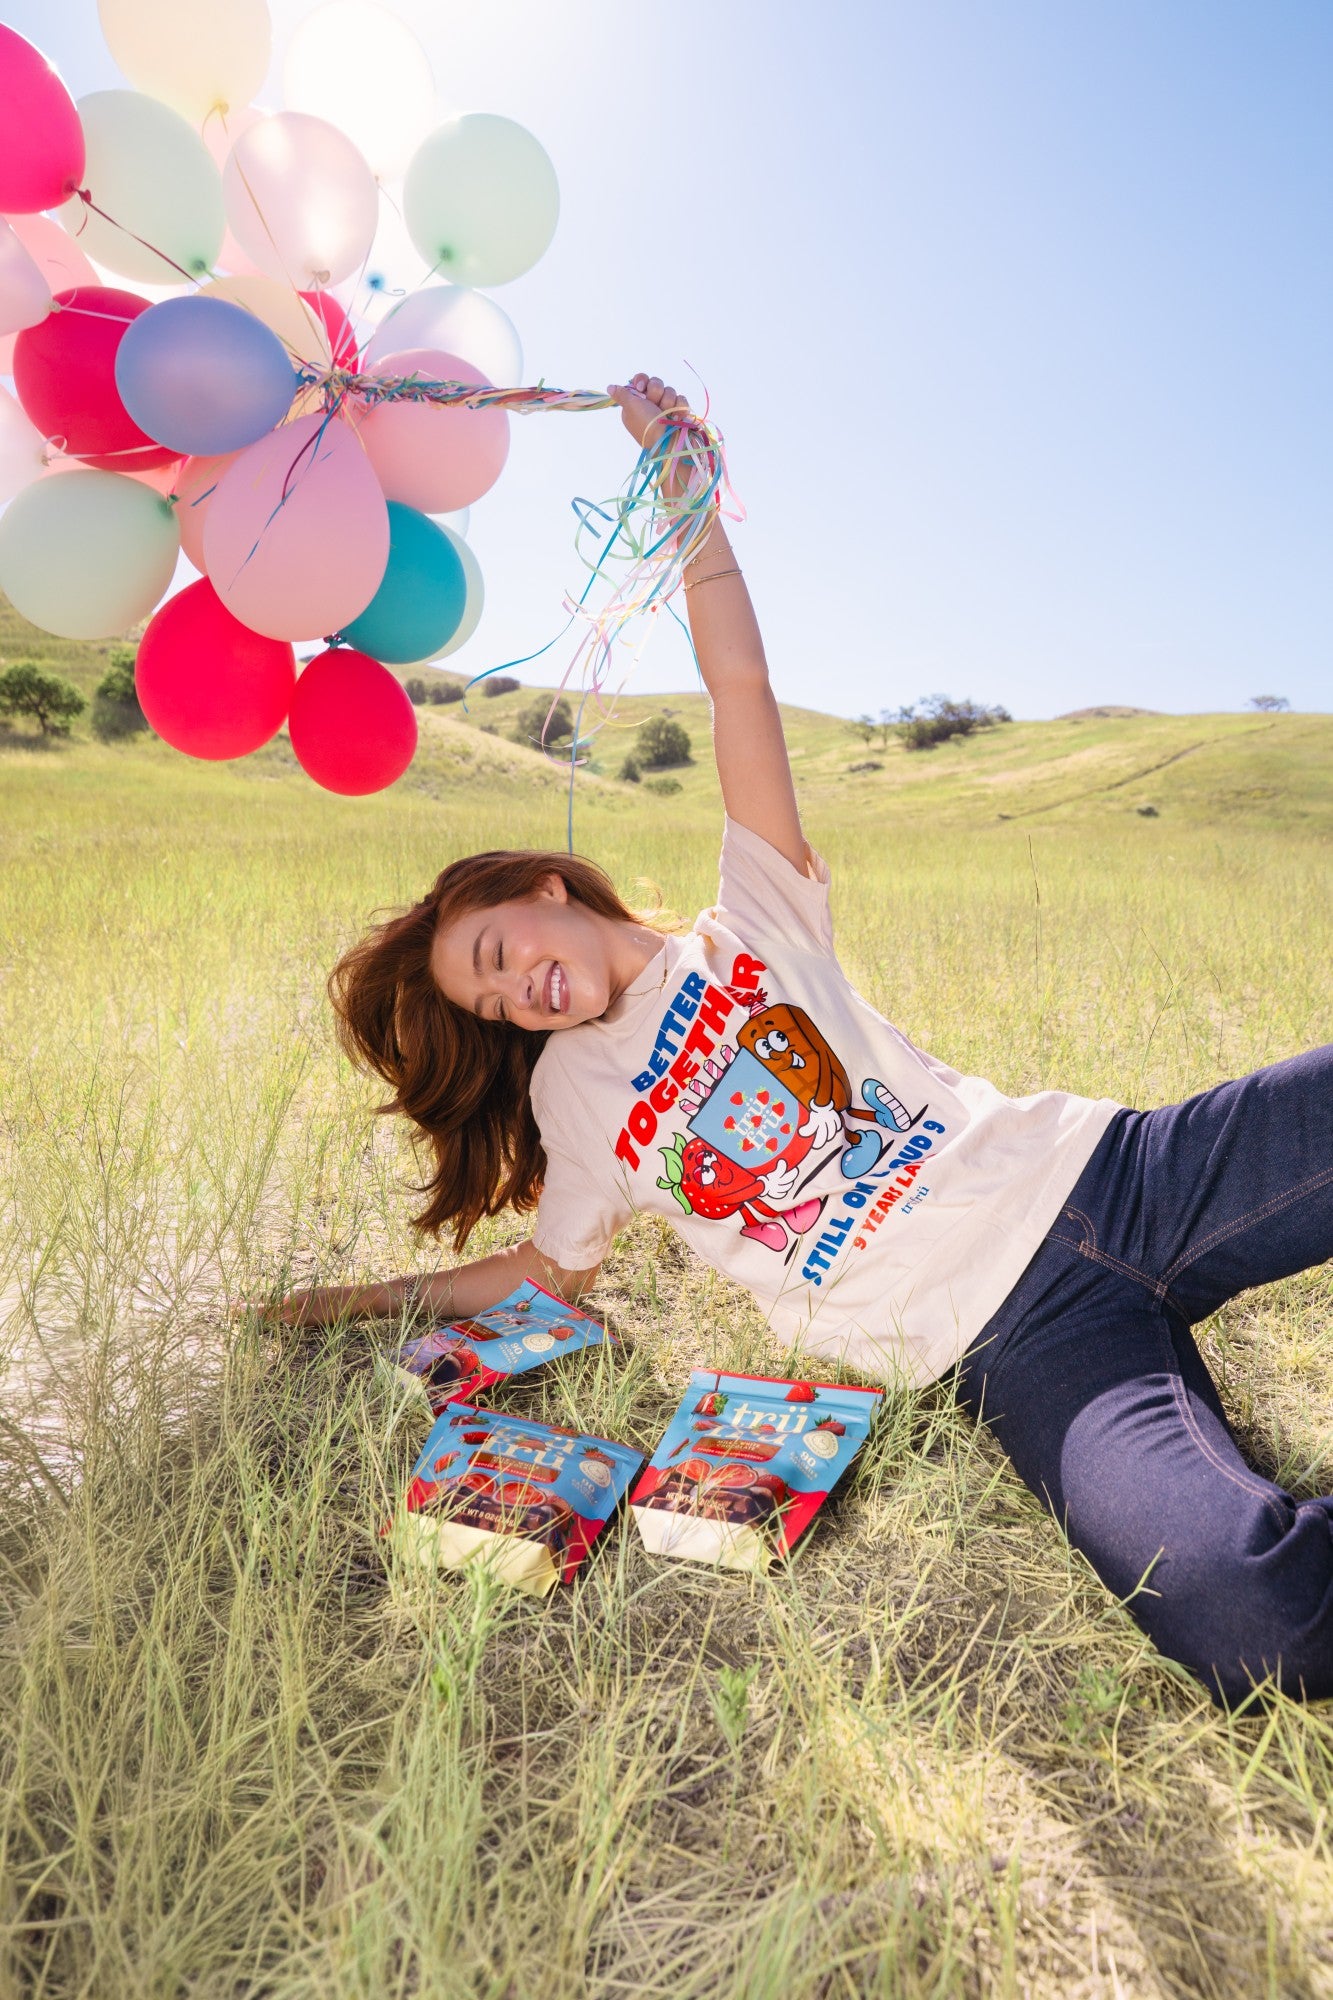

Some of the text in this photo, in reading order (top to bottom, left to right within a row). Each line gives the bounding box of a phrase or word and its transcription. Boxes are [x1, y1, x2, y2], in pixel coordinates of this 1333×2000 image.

[630, 971, 707, 1093] BETTER
[801, 1119, 946, 1287] STILL ON OUD 9
[853, 1236, 867, 1251] 9
[862, 1186, 904, 1234] YEARS
[731, 1402, 808, 1435] trü
[467, 1507, 480, 1518] WT
[479, 1509, 485, 1518] 8
[485, 1512, 495, 1521] OZ
